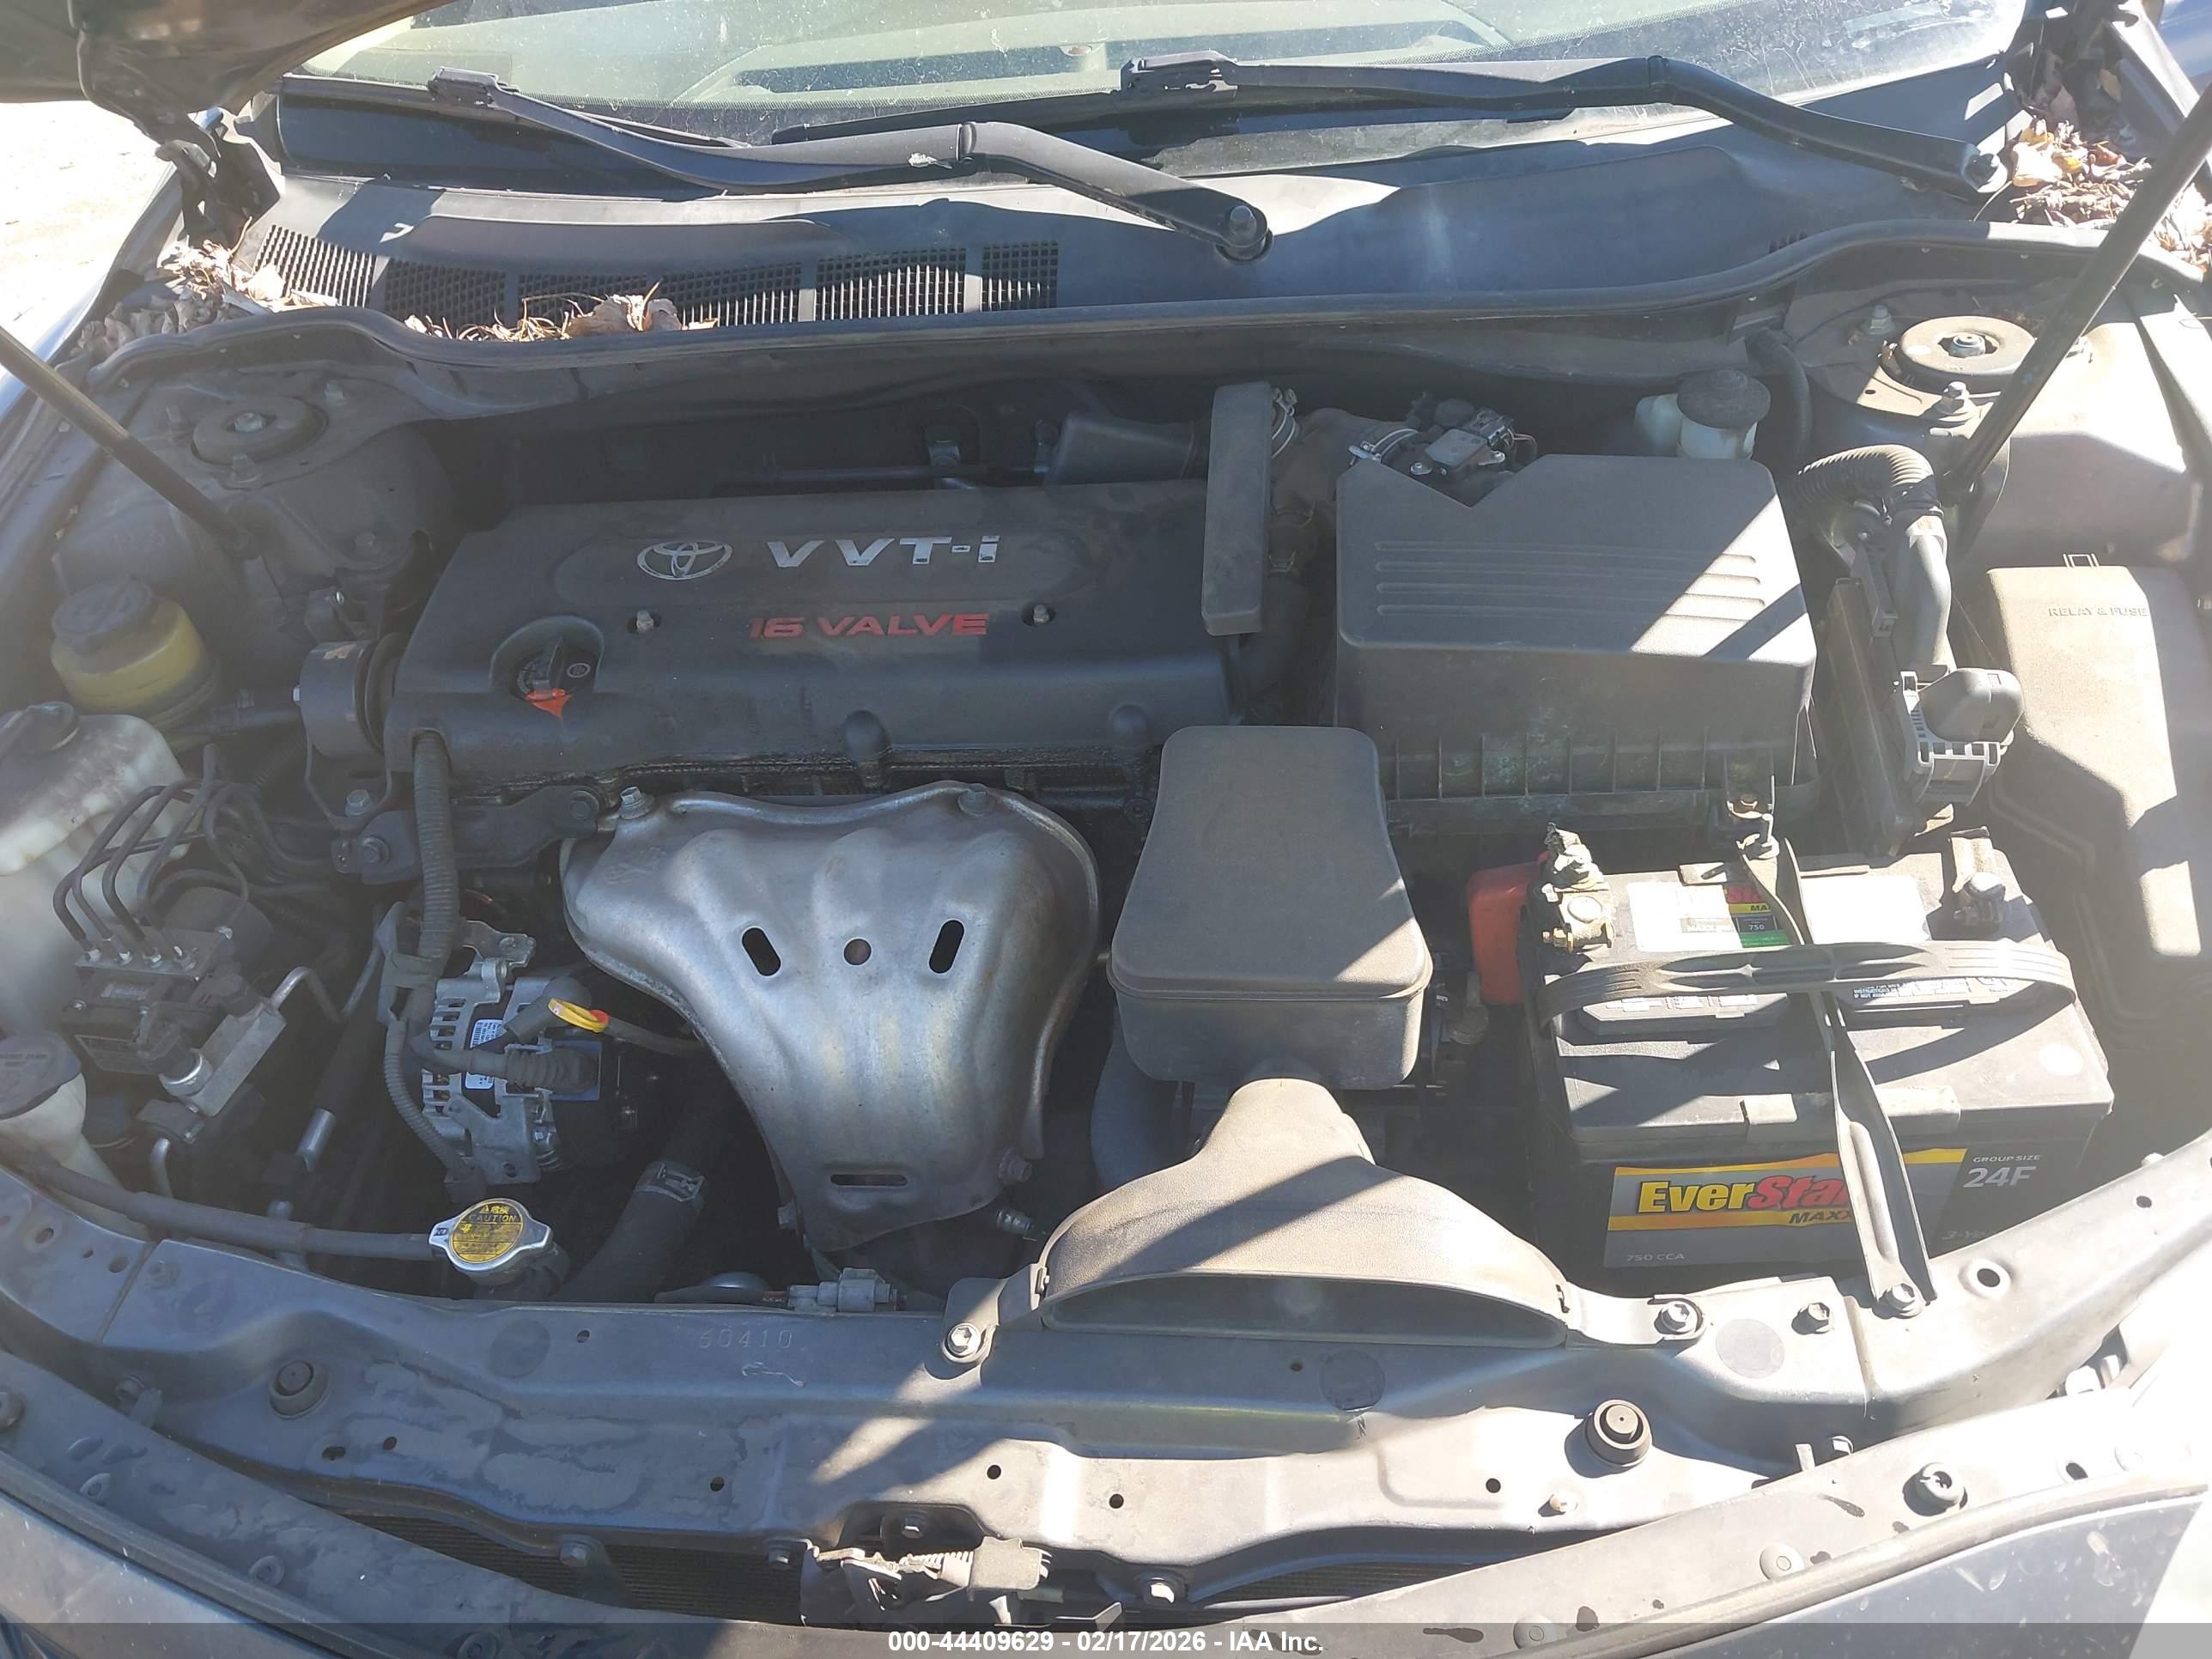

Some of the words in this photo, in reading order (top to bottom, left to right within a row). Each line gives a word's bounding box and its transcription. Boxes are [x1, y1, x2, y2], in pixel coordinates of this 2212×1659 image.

[767, 535, 1000, 568] VVT-i
[2049, 606, 2093, 617] RELAY
[2097, 606, 2108, 616] &
[2110, 606, 2148, 617] FUSE
[749, 617, 805, 639] 16
[817, 613, 990, 636] VALVE
[1963, 1166, 2036, 1188] 24F
[469, 1213, 516, 1223] CAUTION
